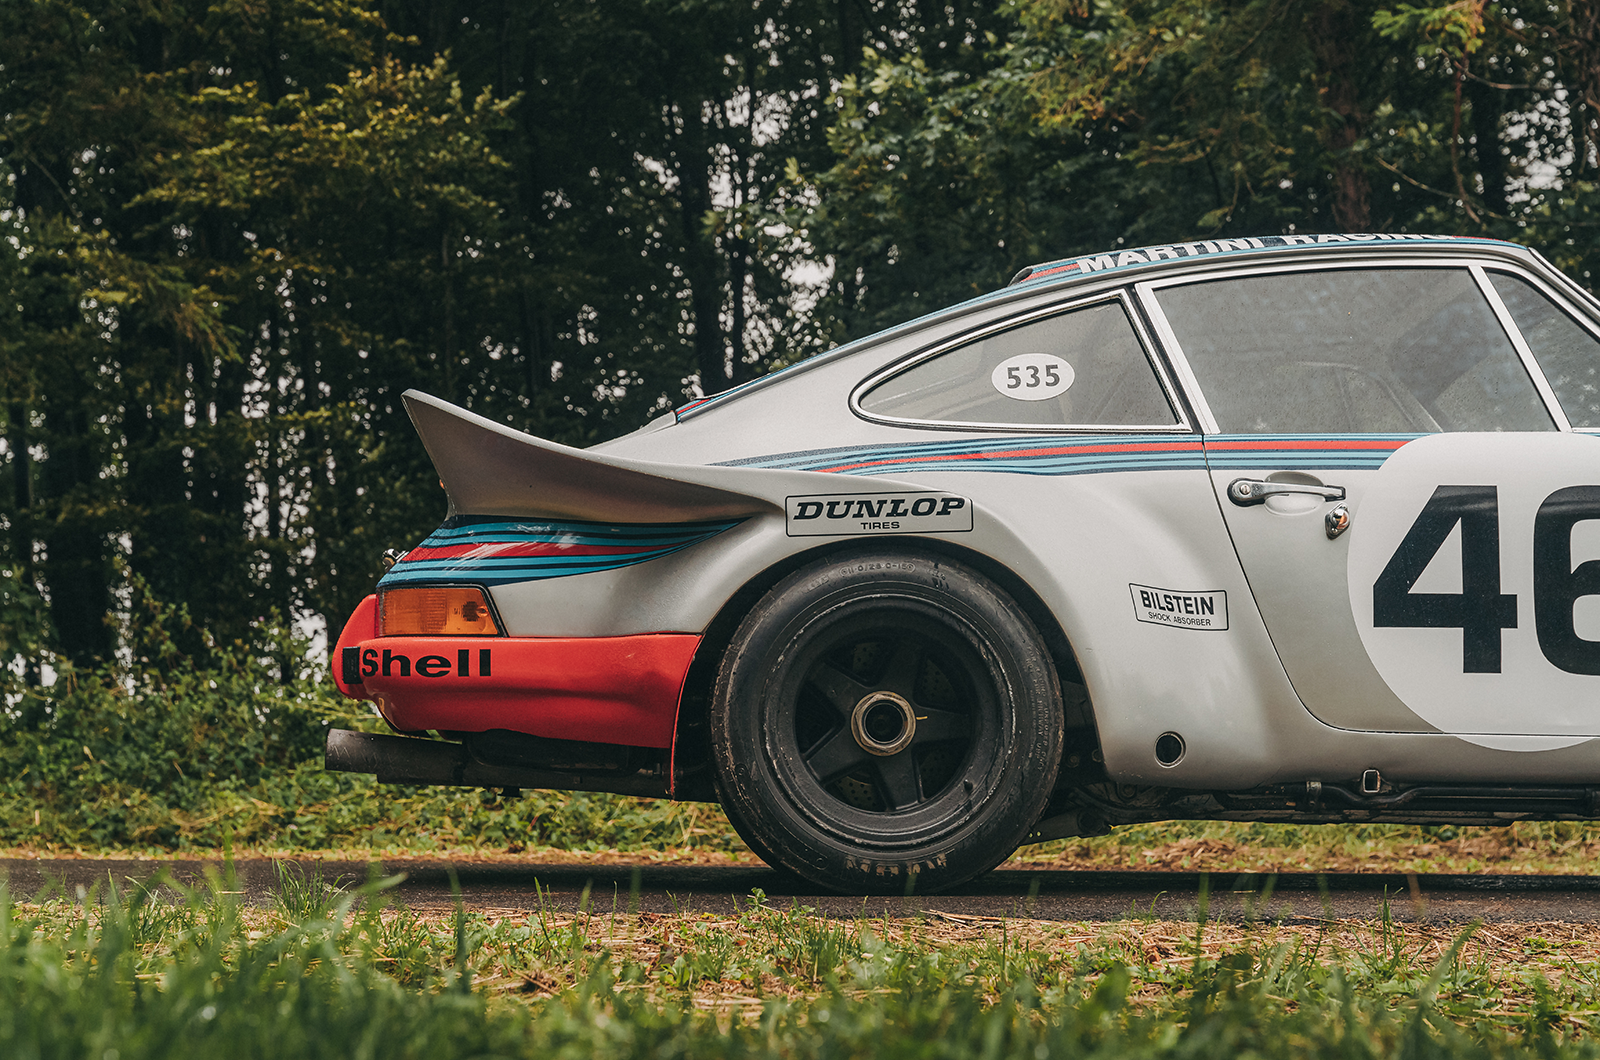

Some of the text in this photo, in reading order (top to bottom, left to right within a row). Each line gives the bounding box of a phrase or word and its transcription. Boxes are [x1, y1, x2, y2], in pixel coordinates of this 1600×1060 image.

[1077, 237, 1265, 274] MARTINI
[1007, 364, 1060, 389] 535
[793, 498, 965, 520] DUNLOP
[860, 521, 900, 530] TIRES
[1373, 485, 1600, 676] 46
[1140, 590, 1214, 615] BILSTEIN
[1148, 611, 1211, 626] SHOCK ABSORBER
[362, 649, 491, 678] Shell
